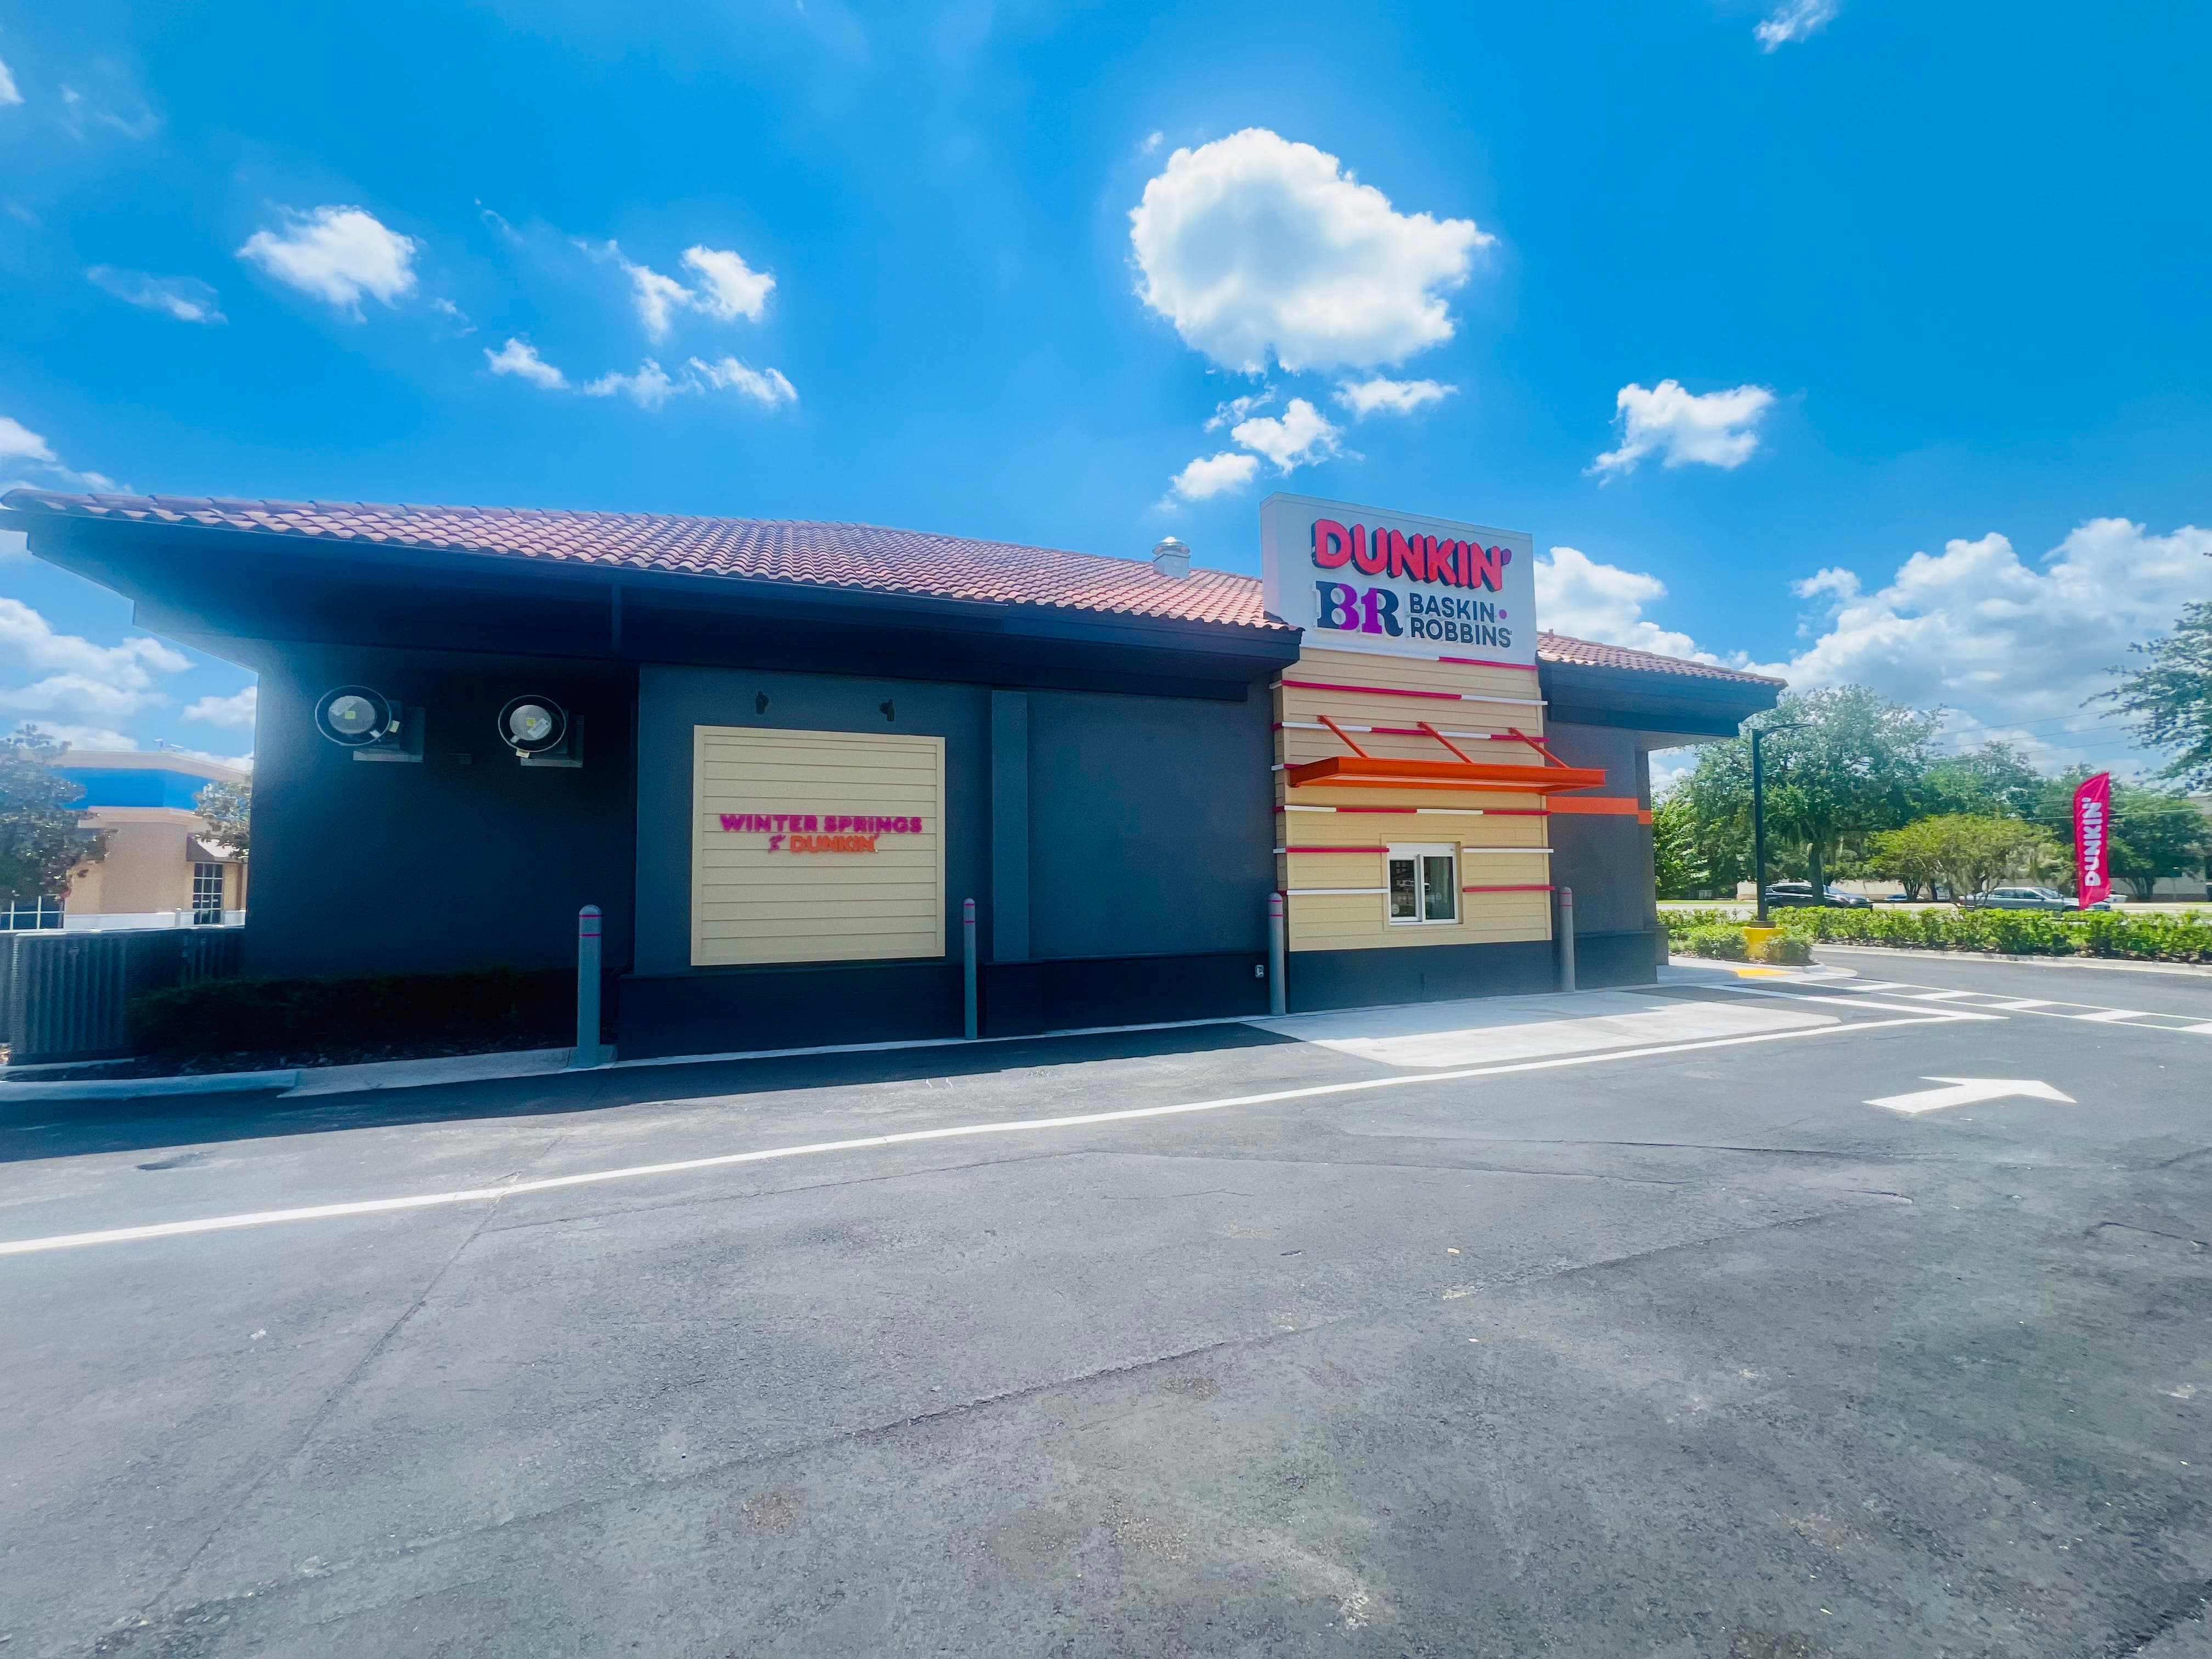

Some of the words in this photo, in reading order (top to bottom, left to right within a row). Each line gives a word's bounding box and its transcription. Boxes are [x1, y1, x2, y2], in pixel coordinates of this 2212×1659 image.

[1311, 518, 1511, 592] DUNKIN'
[1316, 580, 1403, 637] BR
[1410, 617, 1511, 648] ROBBINS
[719, 814, 817, 832] WINTER
[824, 816, 922, 833] SPRINGS
[2081, 797, 2102, 886] DUNKIN'
